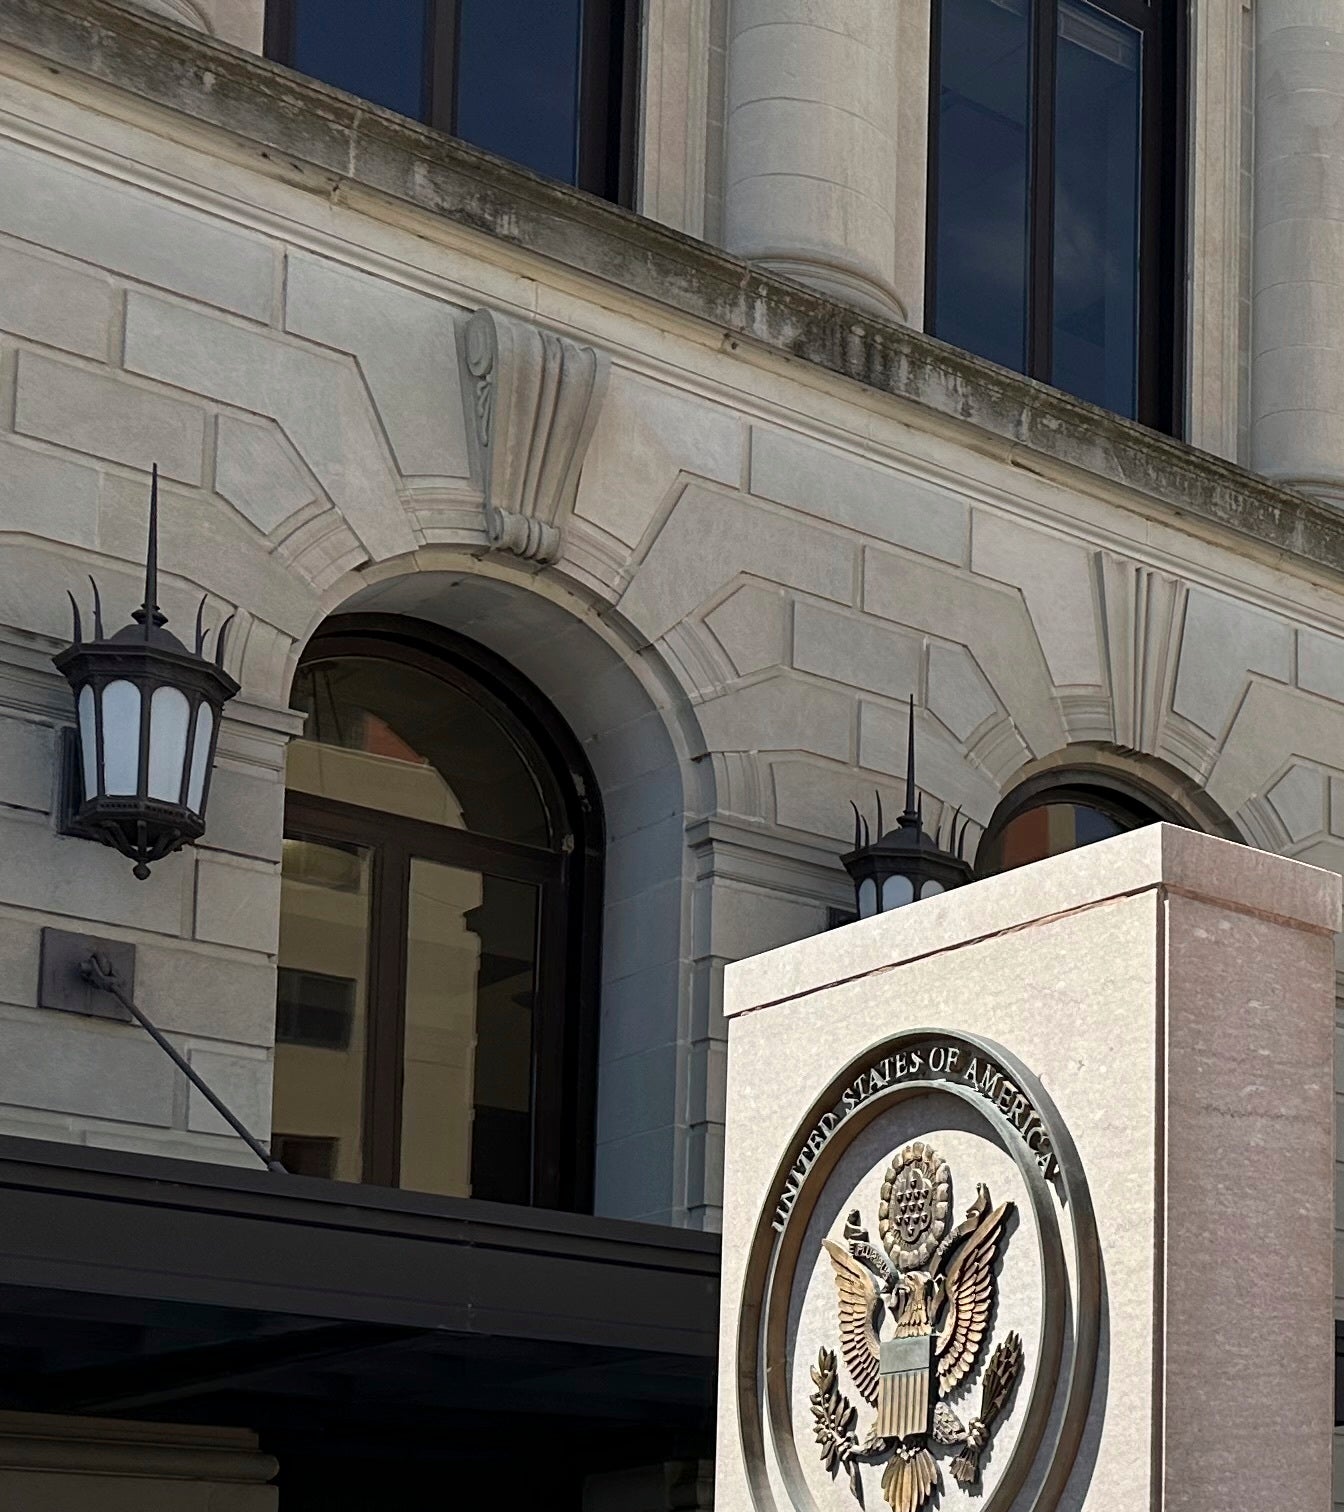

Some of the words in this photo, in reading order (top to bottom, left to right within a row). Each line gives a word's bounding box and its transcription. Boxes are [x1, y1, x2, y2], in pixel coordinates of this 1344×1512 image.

[771, 1111, 839, 1233] UNITED
[842, 1050, 925, 1116] STATES
[928, 1047, 961, 1073] OF
[963, 1057, 1062, 1181] AMERICA
